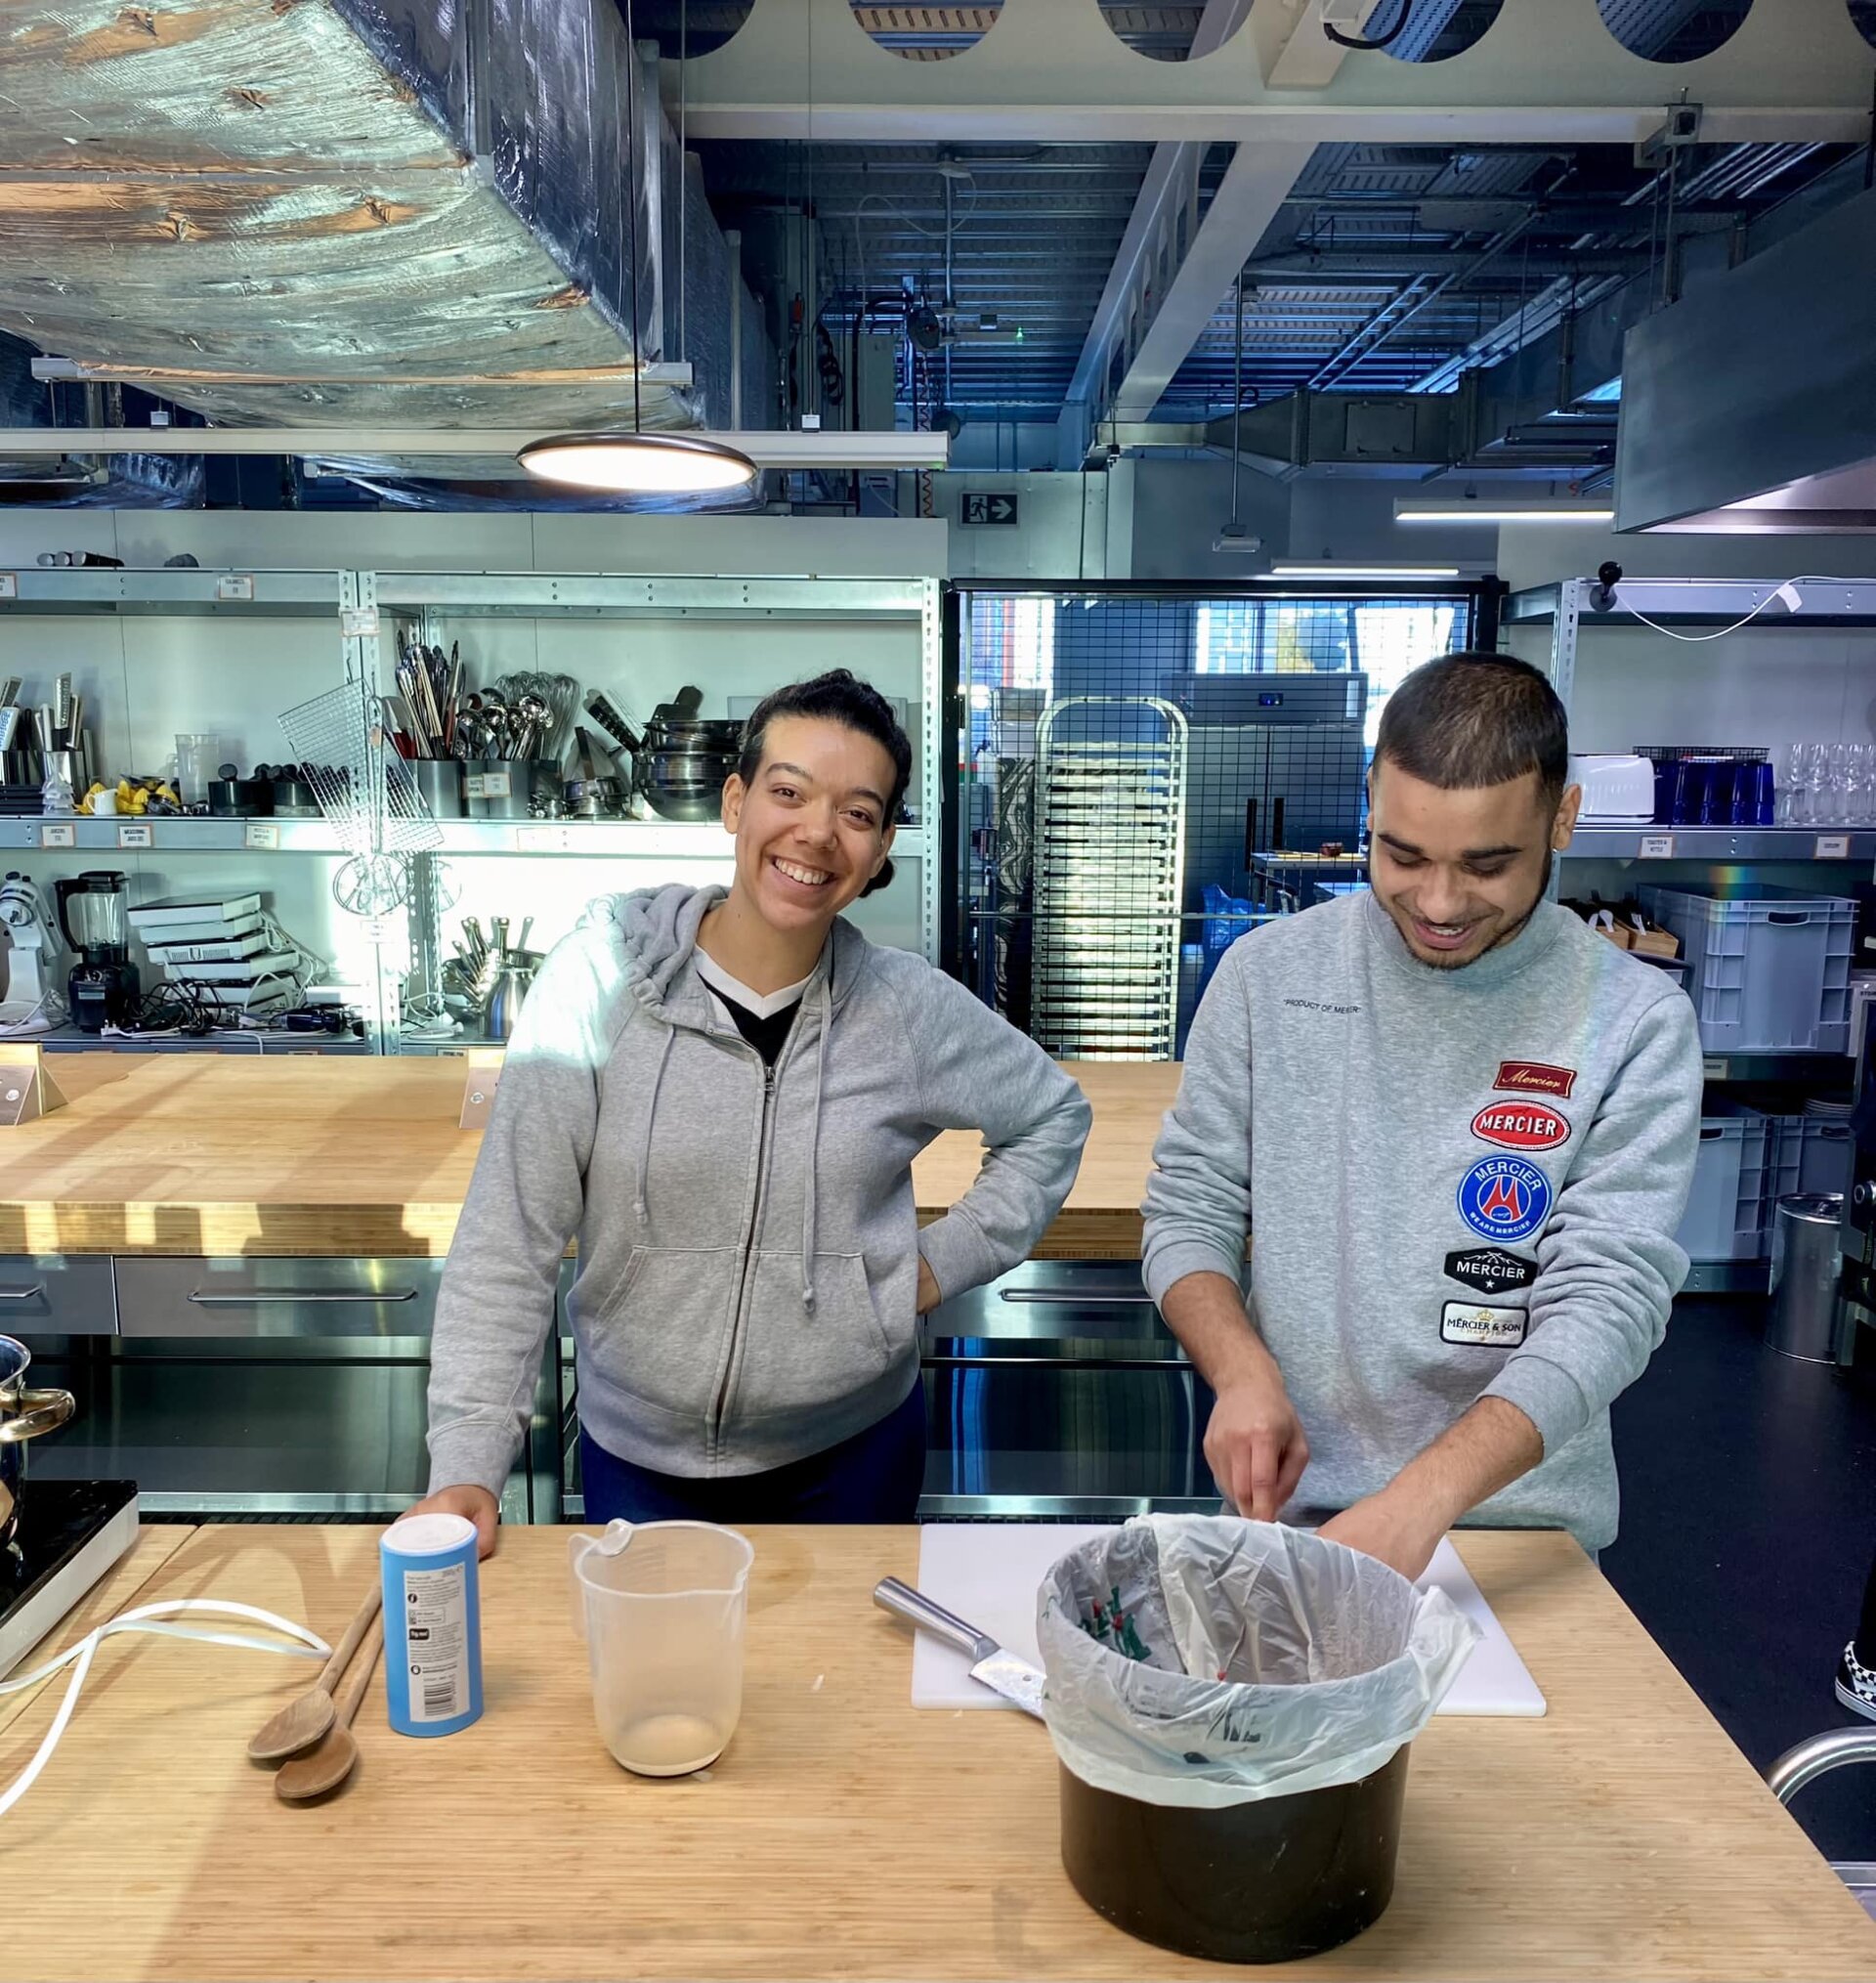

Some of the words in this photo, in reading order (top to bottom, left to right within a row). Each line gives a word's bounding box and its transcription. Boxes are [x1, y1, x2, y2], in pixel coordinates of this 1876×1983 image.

[1321, 1004, 1332, 1013] OF
[1502, 1069, 1560, 1088] Mercier
[1479, 1114, 1556, 1137] MERCIER
[1474, 1161, 1542, 1190] MERCIER
[1496, 1220, 1531, 1233] MERCIER
[1457, 1261, 1525, 1279] MERCIER
[1492, 1322, 1500, 1331] &
[1502, 1323, 1521, 1332] SON
